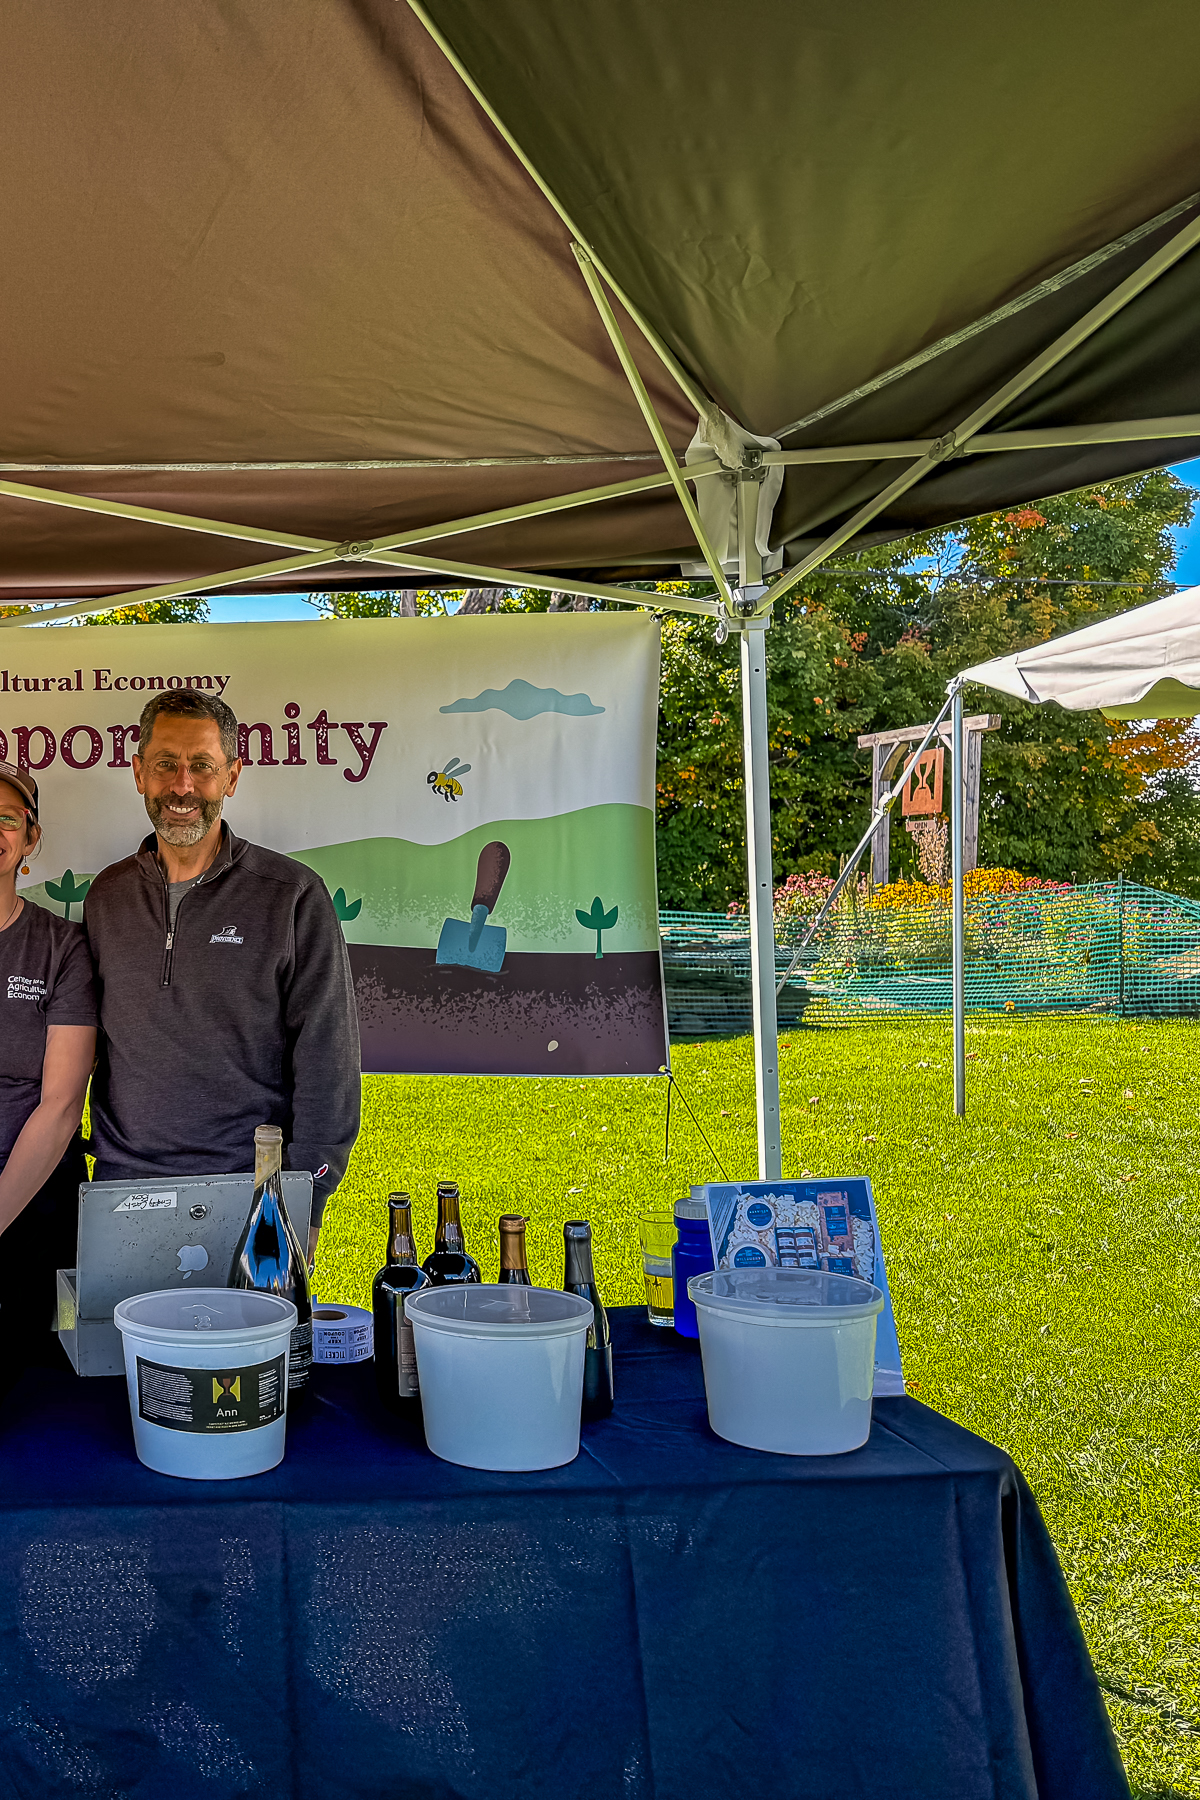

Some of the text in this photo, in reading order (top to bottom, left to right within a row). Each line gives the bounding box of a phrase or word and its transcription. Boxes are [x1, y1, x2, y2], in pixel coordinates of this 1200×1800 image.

[92, 668, 231, 697] Economy
[7, 975, 32, 985] Center
[7, 990, 40, 1001] Econom
[325, 1351, 346, 1359] TICKET
[355, 1346, 369, 1357] TICKET
[216, 1408, 238, 1418] Ann
